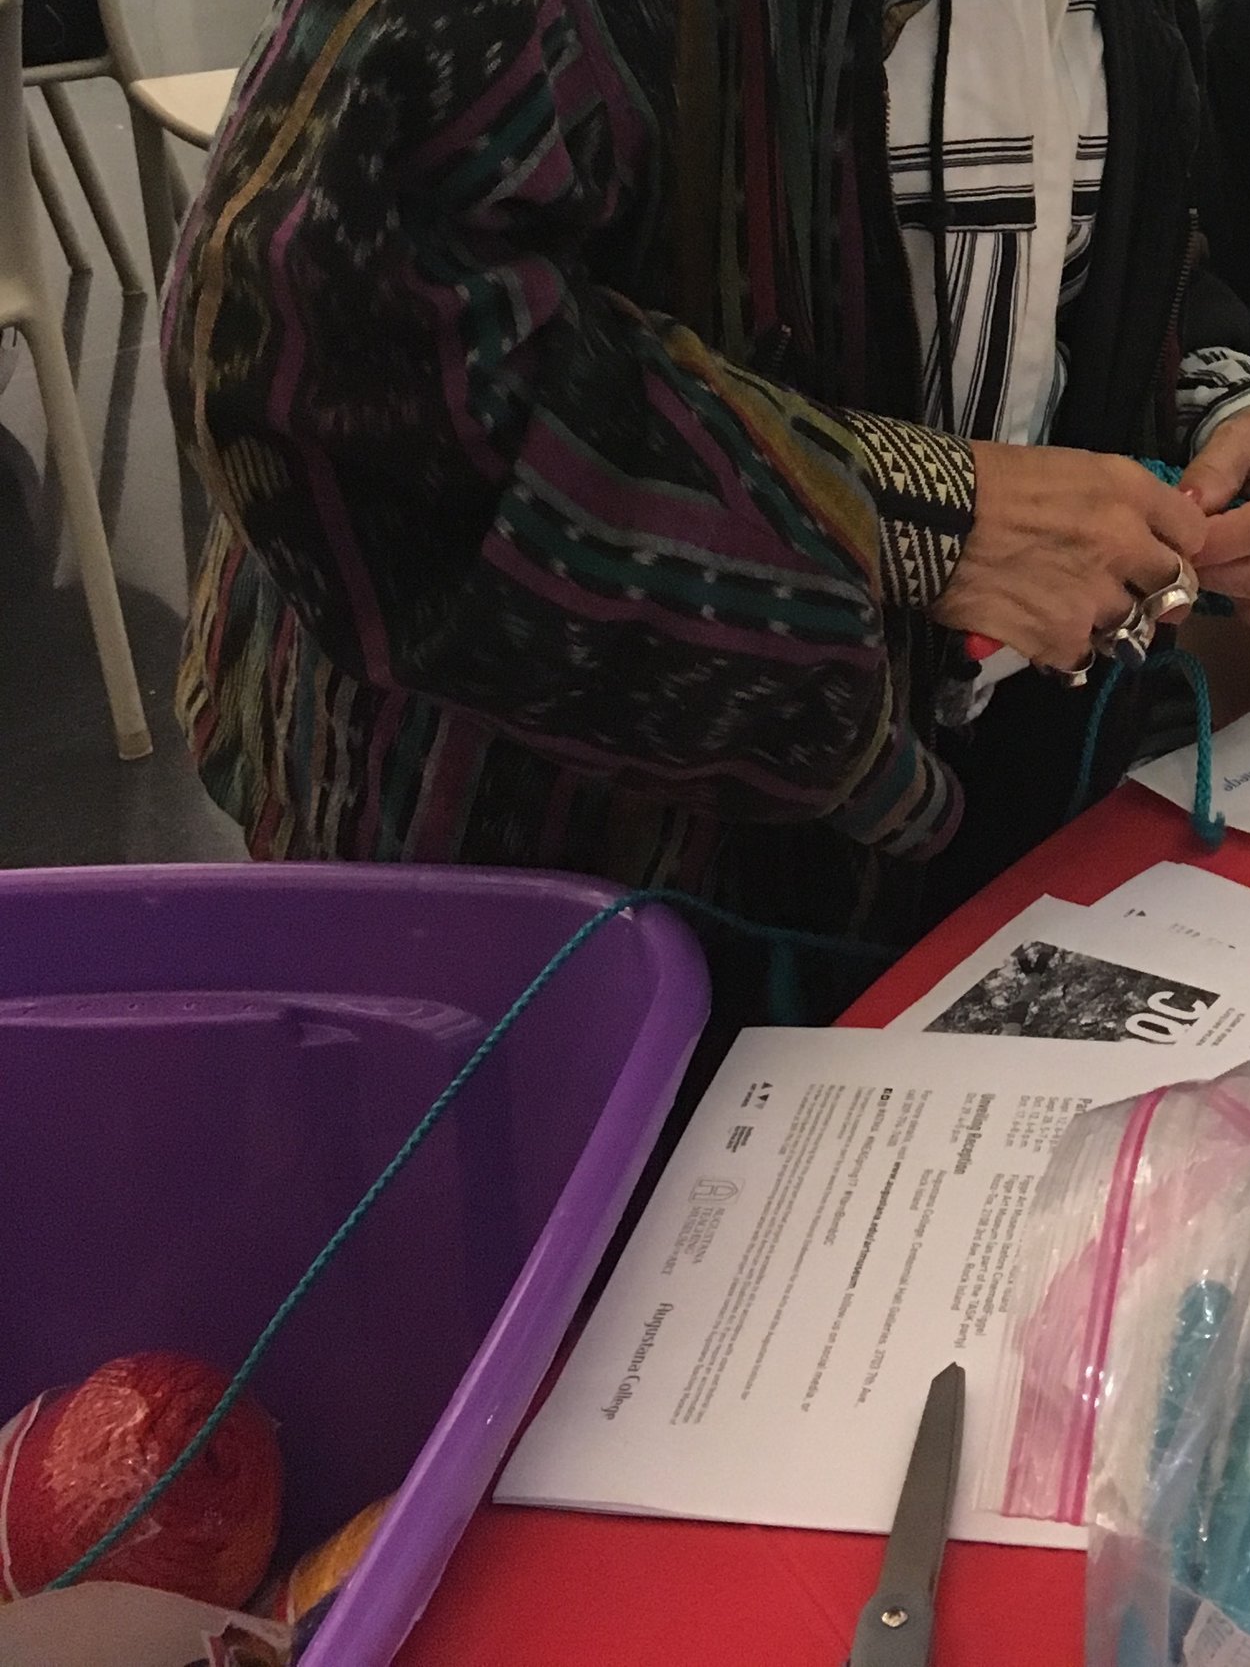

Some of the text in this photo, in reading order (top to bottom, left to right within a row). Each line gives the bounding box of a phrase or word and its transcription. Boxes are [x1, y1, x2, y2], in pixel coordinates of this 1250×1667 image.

[954, 1132, 981, 1174] Reception
[600, 1303, 672, 1419] Augustana College
